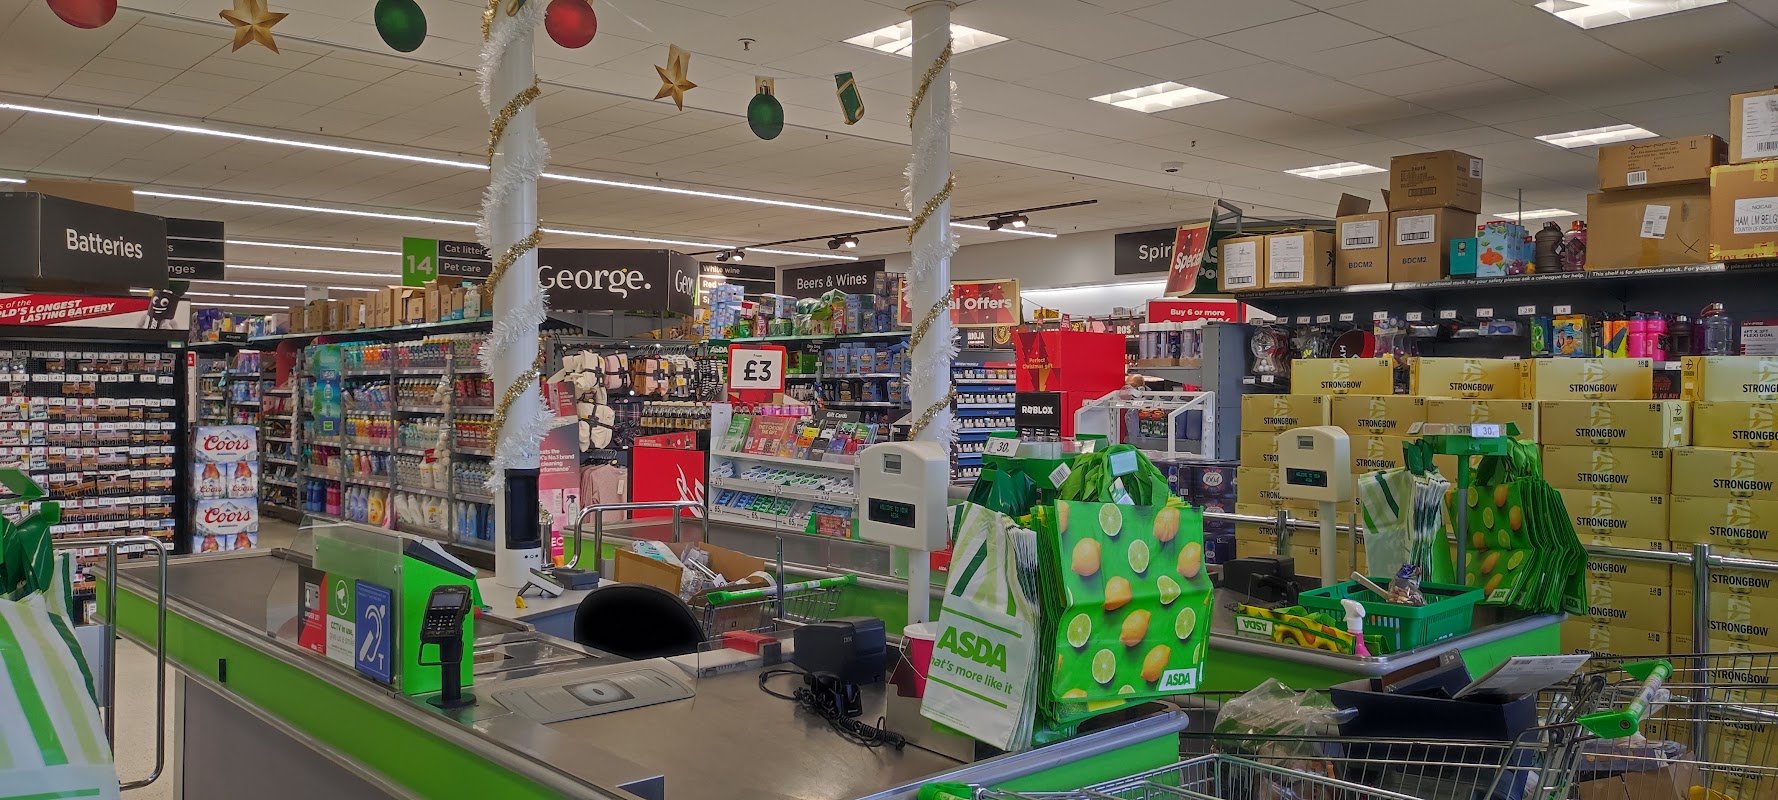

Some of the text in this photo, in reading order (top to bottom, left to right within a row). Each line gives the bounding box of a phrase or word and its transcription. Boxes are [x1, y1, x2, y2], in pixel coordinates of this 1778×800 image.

[66, 228, 143, 259] Batteries
[444, 244, 484, 256] Cat litter
[406, 254, 432, 274] 14
[1348, 261, 1372, 269] BDCM2
[1402, 256, 1427, 264] BDCM2
[444, 262, 482, 273] Pet care
[702, 264, 740, 274] White wine
[703, 280, 717, 288] Red
[796, 273, 868, 290] Beers & Wines
[6, 300, 16, 308] of
[29, 299, 82, 313] LONGEST
[964, 298, 1012, 310] Offers
[20, 303, 115, 323] LASTING BATTERY
[1170, 309, 1186, 317] Buy
[968, 332, 984, 340] RIOJA
[744, 360, 772, 381] £3
[1321, 381, 1362, 389] STRONGBOW
[1449, 382, 1494, 392] STRONGBOW
[1569, 384, 1618, 392] STRONGBOW
[1022, 406, 1053, 414] ROBLOX
[1263, 417, 1299, 426] STRONGBOW
[1358, 419, 1397, 428] STRONGBOW
[1575, 428, 1626, 438] STRONGBOW
[204, 435, 250, 451] Coors
[1356, 458, 1396, 468] STRONGBOW
[1577, 473, 1629, 484] STRONGBOW
[200, 485, 222, 493] Coors
[232, 484, 254, 492] Coors
[1713, 479, 1772, 491] STRONGBOW
[204, 508, 251, 524] Coors
[1576, 517, 1628, 528] STRONGBOW
[1709, 526, 1768, 539] STRONGBOW
[1712, 574, 1770, 588] STRONGBOW
[331, 621, 341, 630] CCTV
[1242, 620, 1268, 632] ASDA
[1710, 621, 1768, 636] STRONGBOW
[937, 626, 1007, 673] ASDA
[956, 665, 983, 682] more
[984, 674, 1002, 690] like
[1004, 682, 1013, 694] it
[1166, 672, 1191, 686] ASDA
